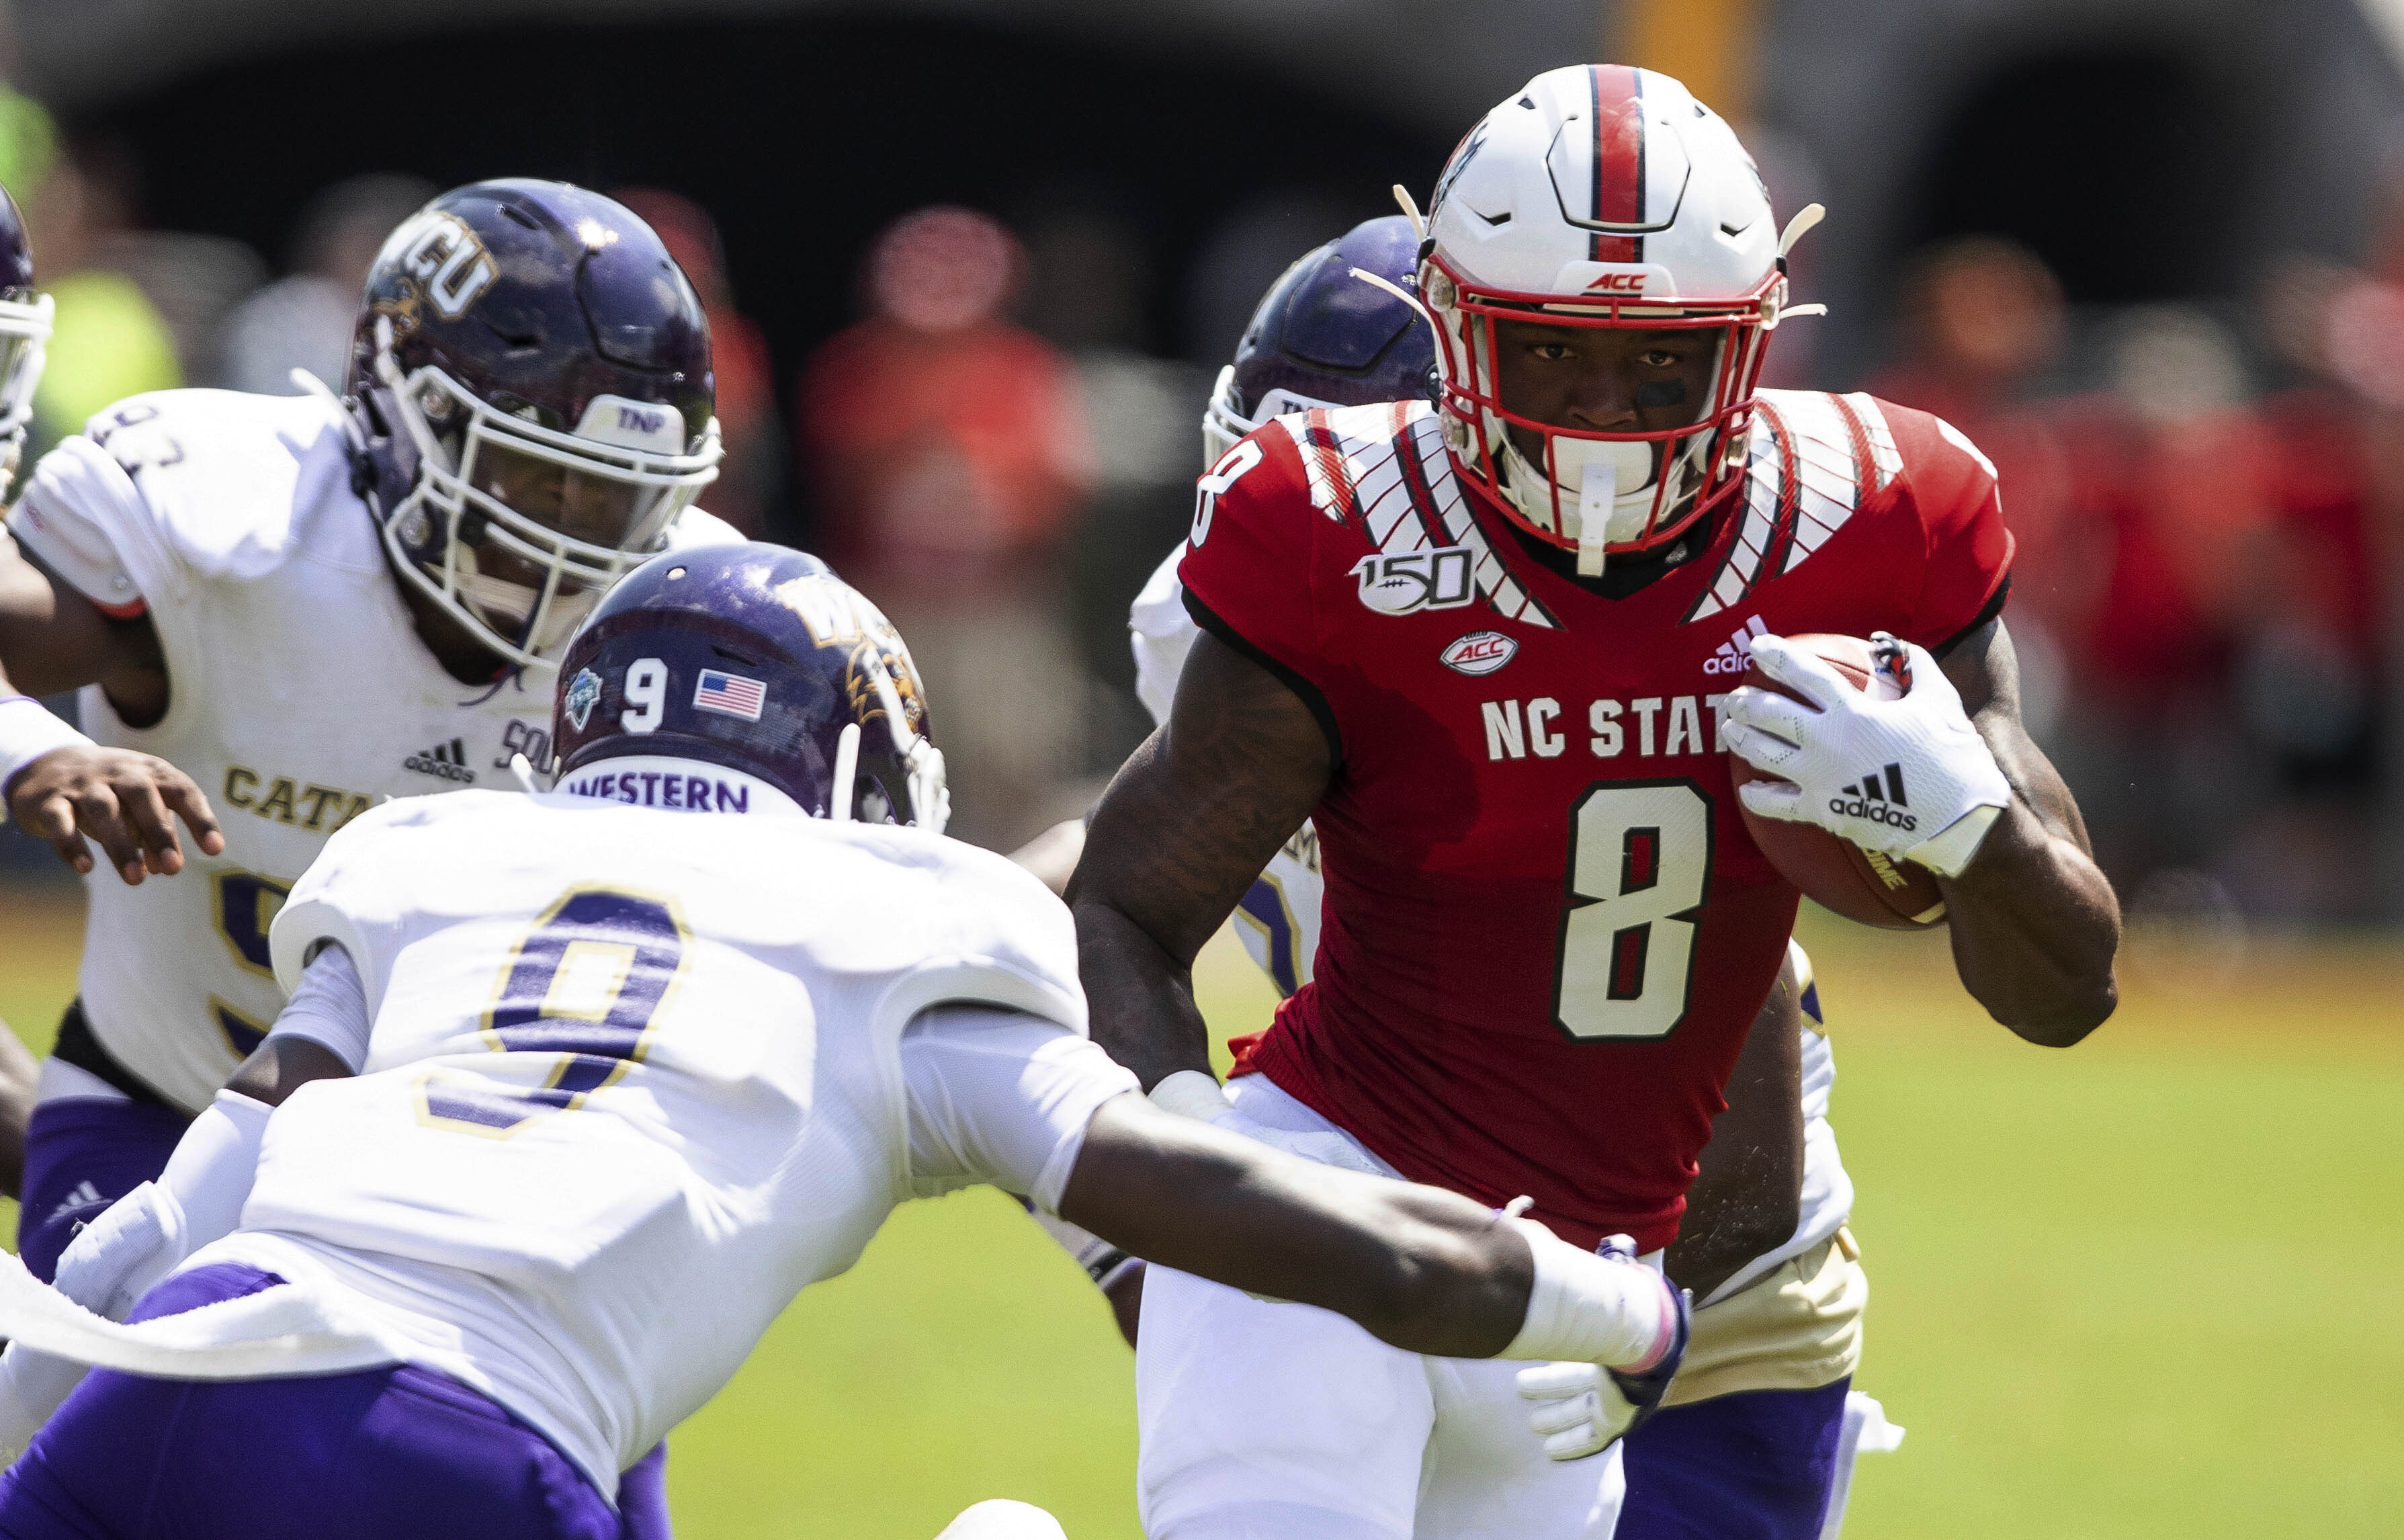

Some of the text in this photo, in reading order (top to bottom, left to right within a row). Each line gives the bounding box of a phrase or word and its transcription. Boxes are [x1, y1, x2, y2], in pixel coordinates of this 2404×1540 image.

[1586, 273, 1647, 290] ACC
[1190, 438, 1264, 550] 8
[1361, 548, 1473, 611] 150
[1453, 638, 1504, 660] ACC
[621, 658, 669, 736] 9
[1481, 697, 1566, 761] NC
[404, 756, 476, 784] adidas
[569, 772, 749, 814] WESTERN
[1829, 797, 1918, 832] adidas
[1550, 776, 1715, 1043] 8
[411, 882, 695, 1141] 9
